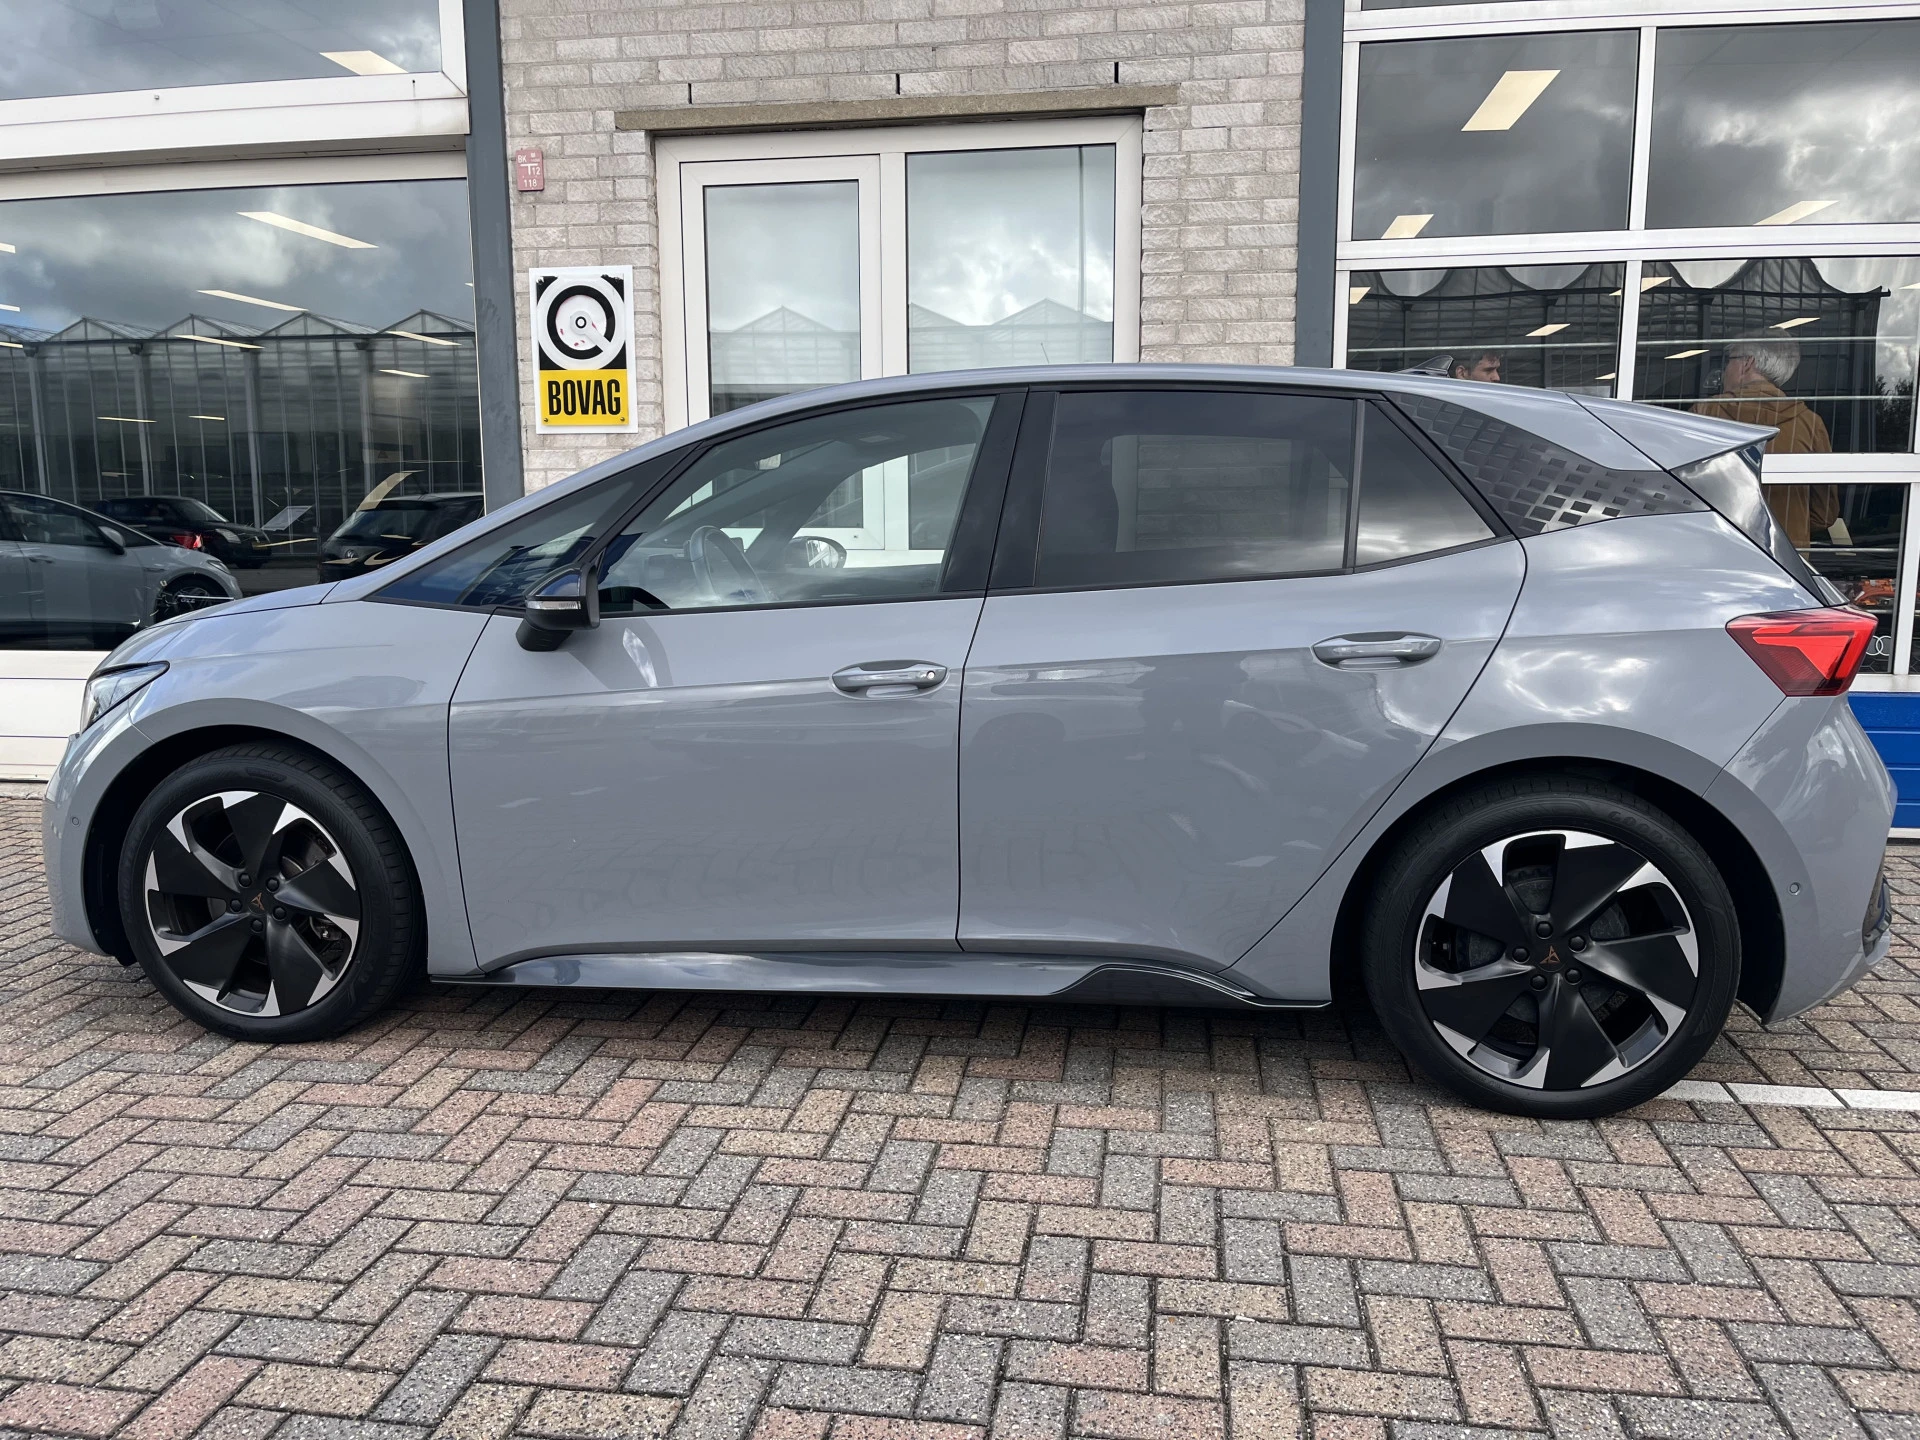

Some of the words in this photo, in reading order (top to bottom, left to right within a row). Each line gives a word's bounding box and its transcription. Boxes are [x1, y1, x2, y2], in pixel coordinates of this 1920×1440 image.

[517, 154, 527, 163] BK
[532, 166, 541, 175] 12
[523, 178, 537, 187] 118
[547, 378, 621, 416] BOVAG
